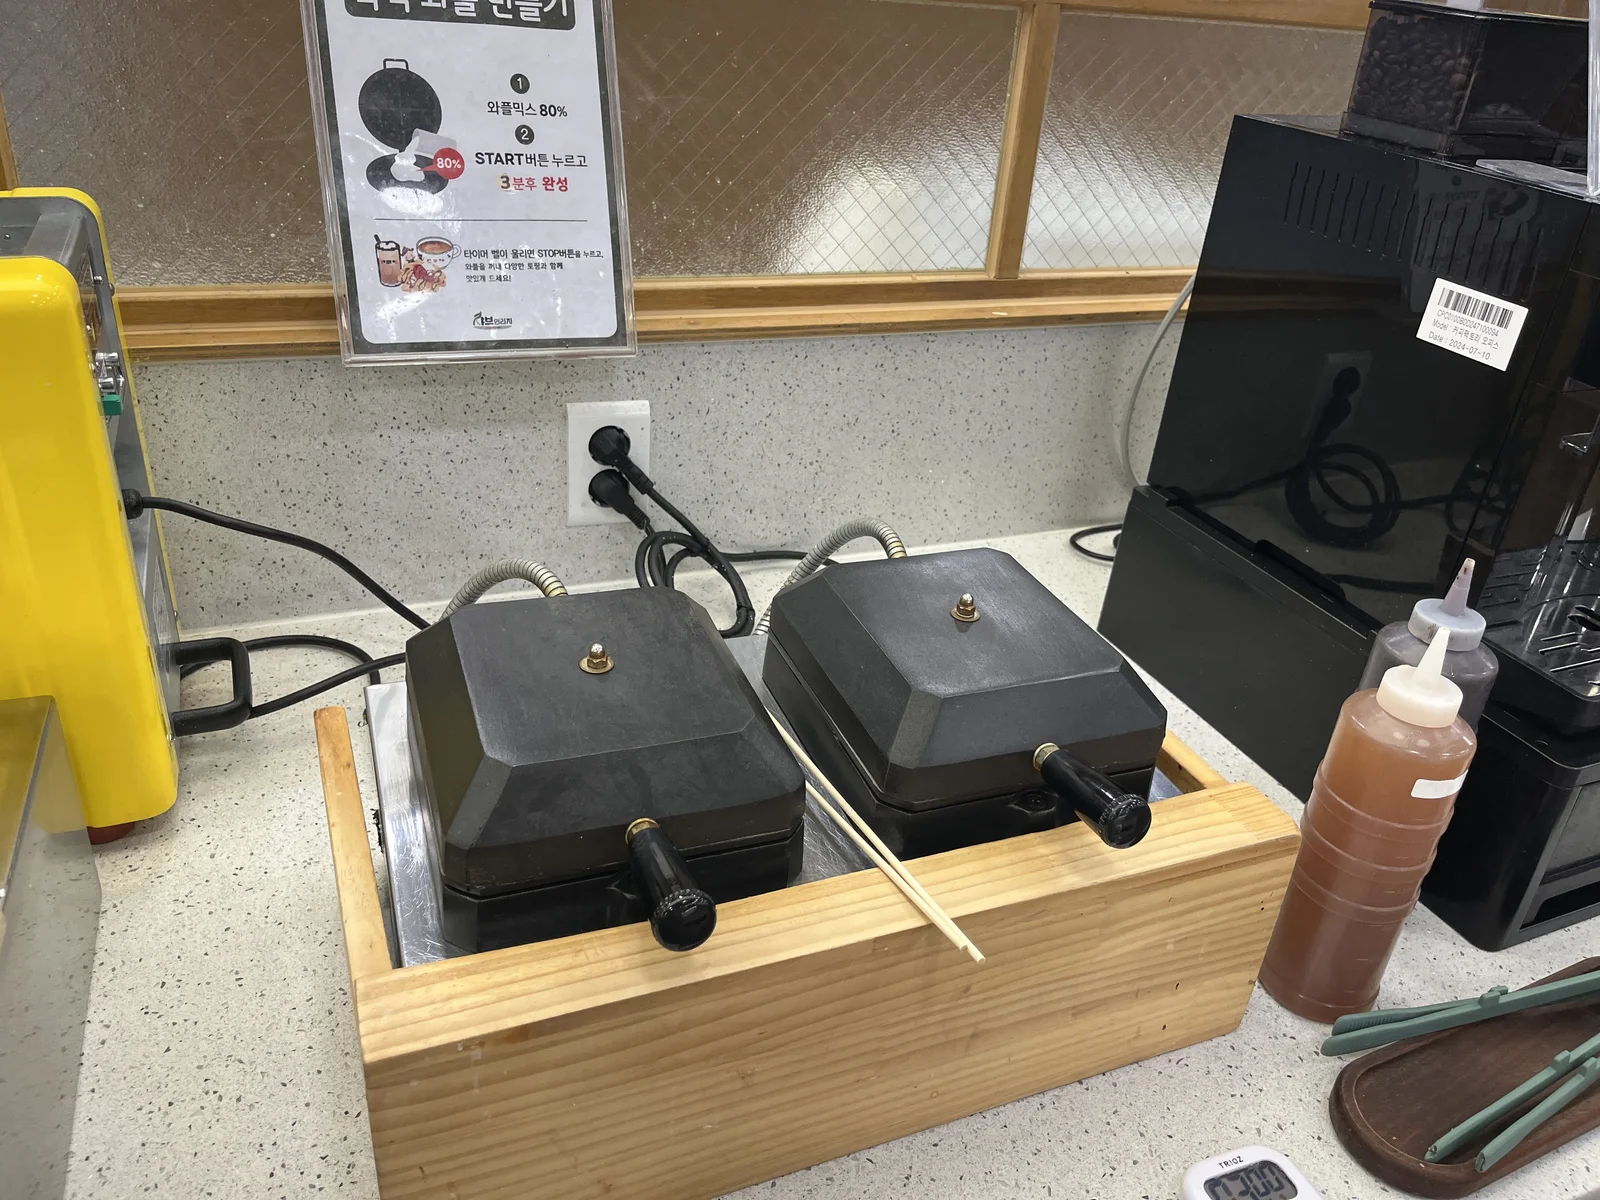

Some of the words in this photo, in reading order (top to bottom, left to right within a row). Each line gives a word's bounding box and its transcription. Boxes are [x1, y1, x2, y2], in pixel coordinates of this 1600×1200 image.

[487, 101, 537, 116] 와플믹스
[539, 104, 568, 117] 80%
[436, 157, 462, 169] 80%
[551, 154, 588, 168] 누르고
[542, 176, 569, 192] 완성
[463, 249, 488, 259] 타이머
[491, 249, 508, 260] 벨이
[511, 248, 535, 259] 울리면
[537, 249, 581, 259] STOP버튼을
[465, 262, 486, 271] 와플을
[504, 262, 525, 271] 다양한
[549, 261, 564, 271] 함께
[1428, 330, 1444, 344] Date
[1448, 338, 1491, 361] 2024-07-10
